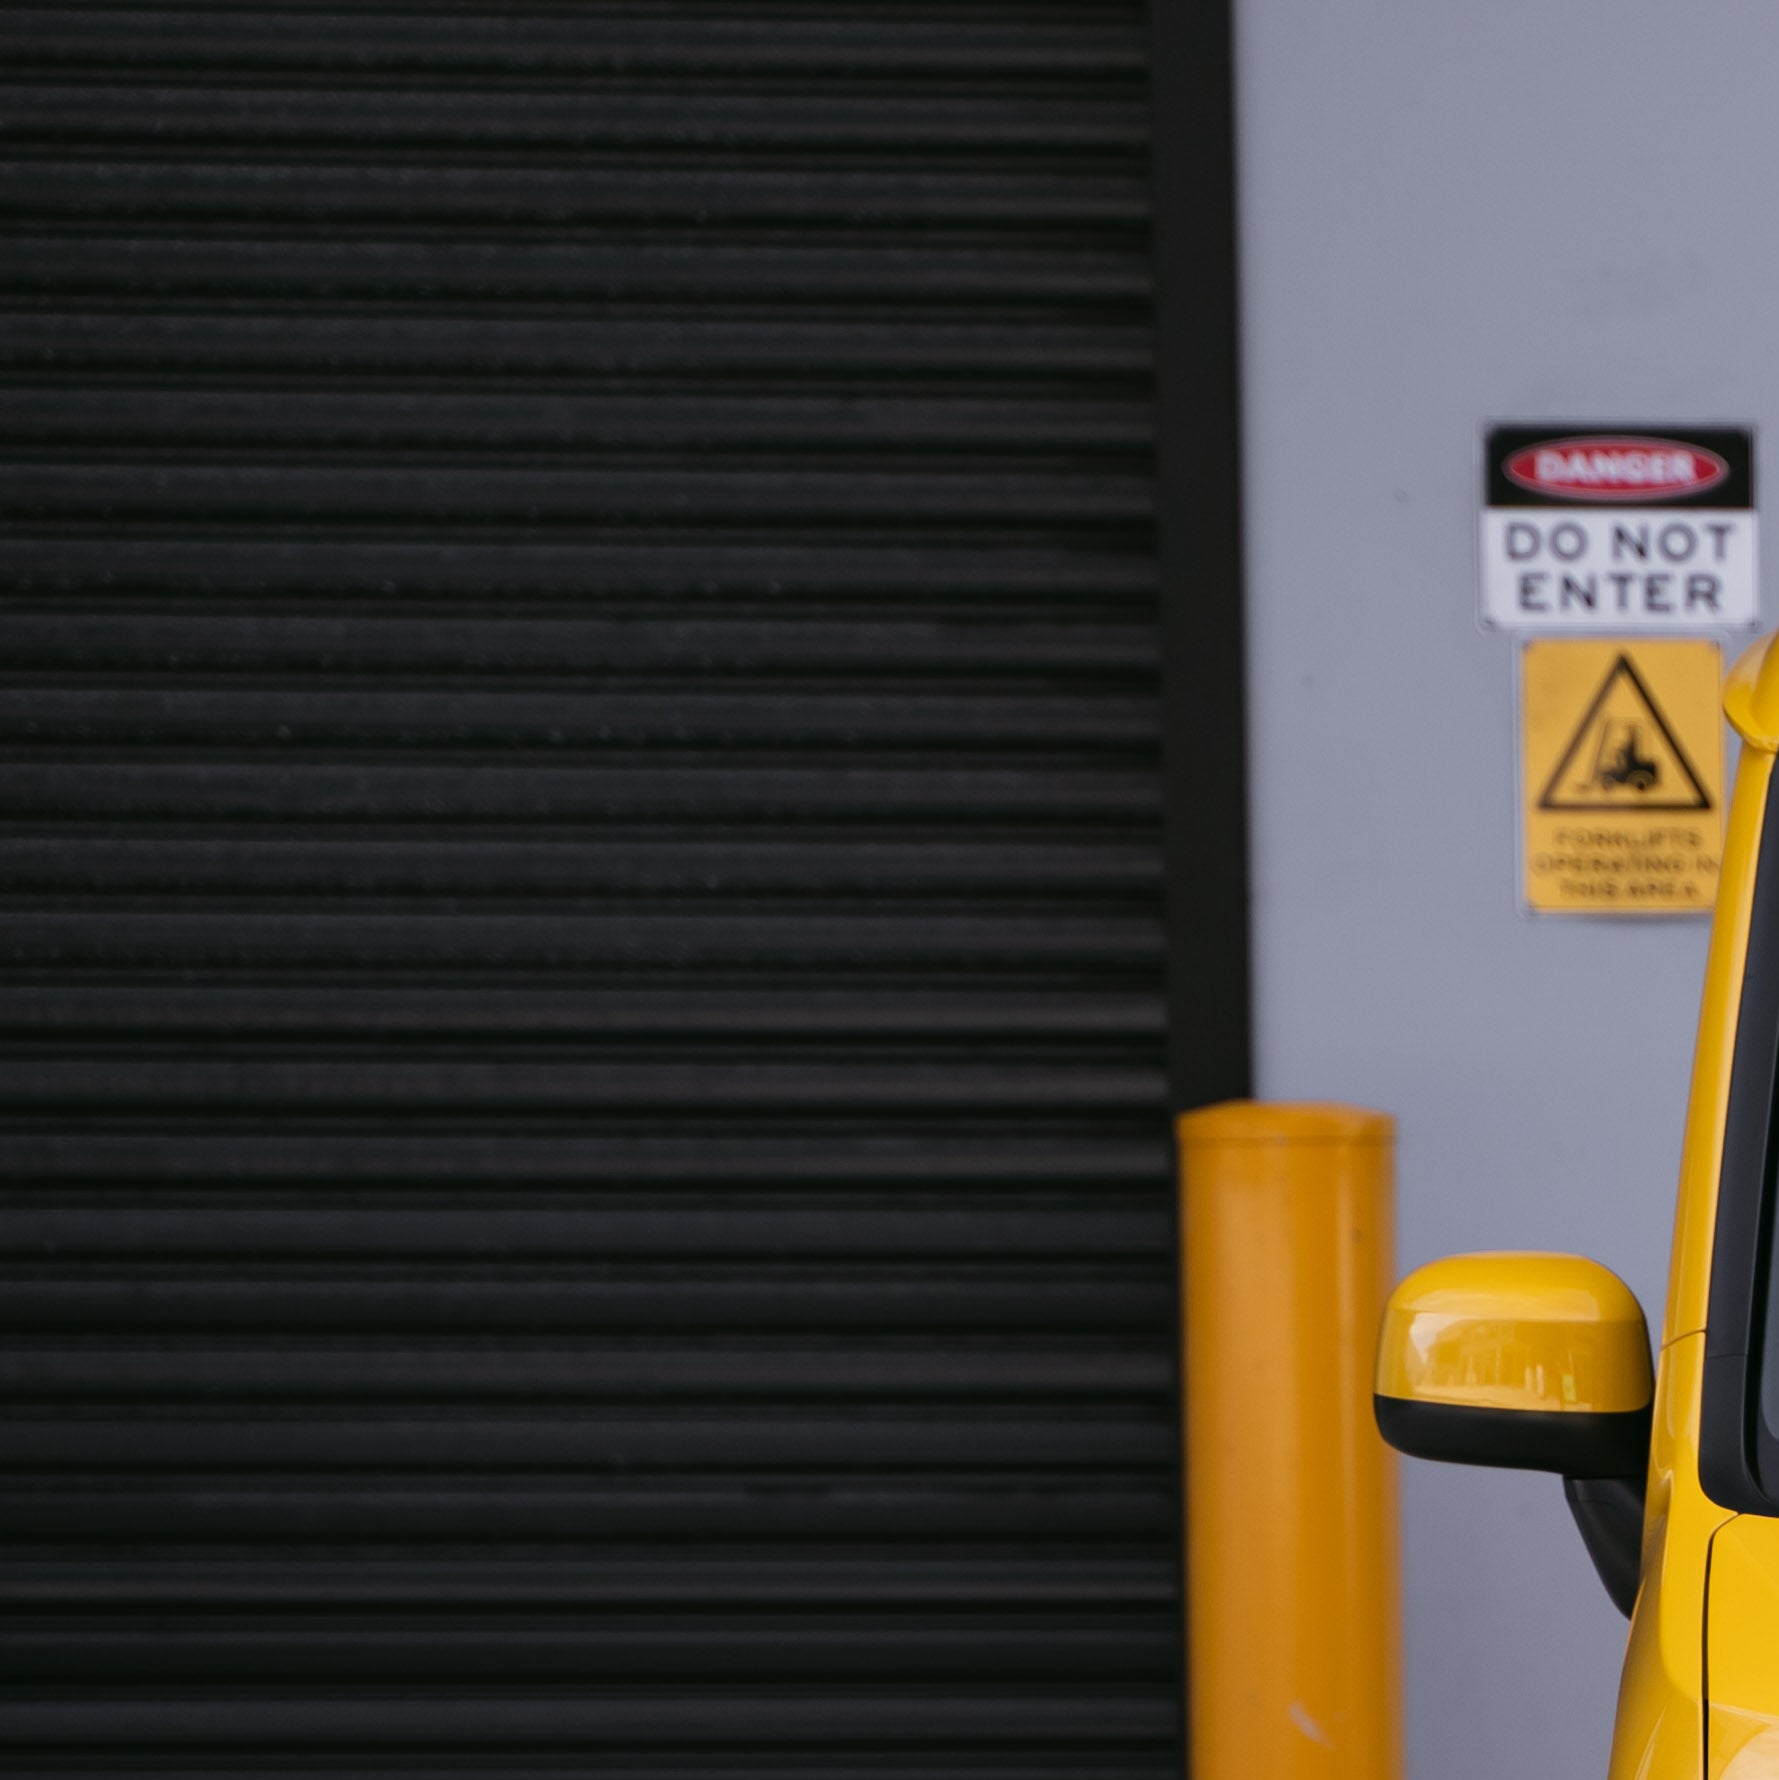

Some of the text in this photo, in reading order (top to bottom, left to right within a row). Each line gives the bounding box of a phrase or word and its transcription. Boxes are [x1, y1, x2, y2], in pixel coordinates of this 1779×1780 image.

[1535, 450, 1697, 484] DANGER
[1506, 523, 1733, 561] DO NOT
[1520, 573, 1722, 611] ENTER
